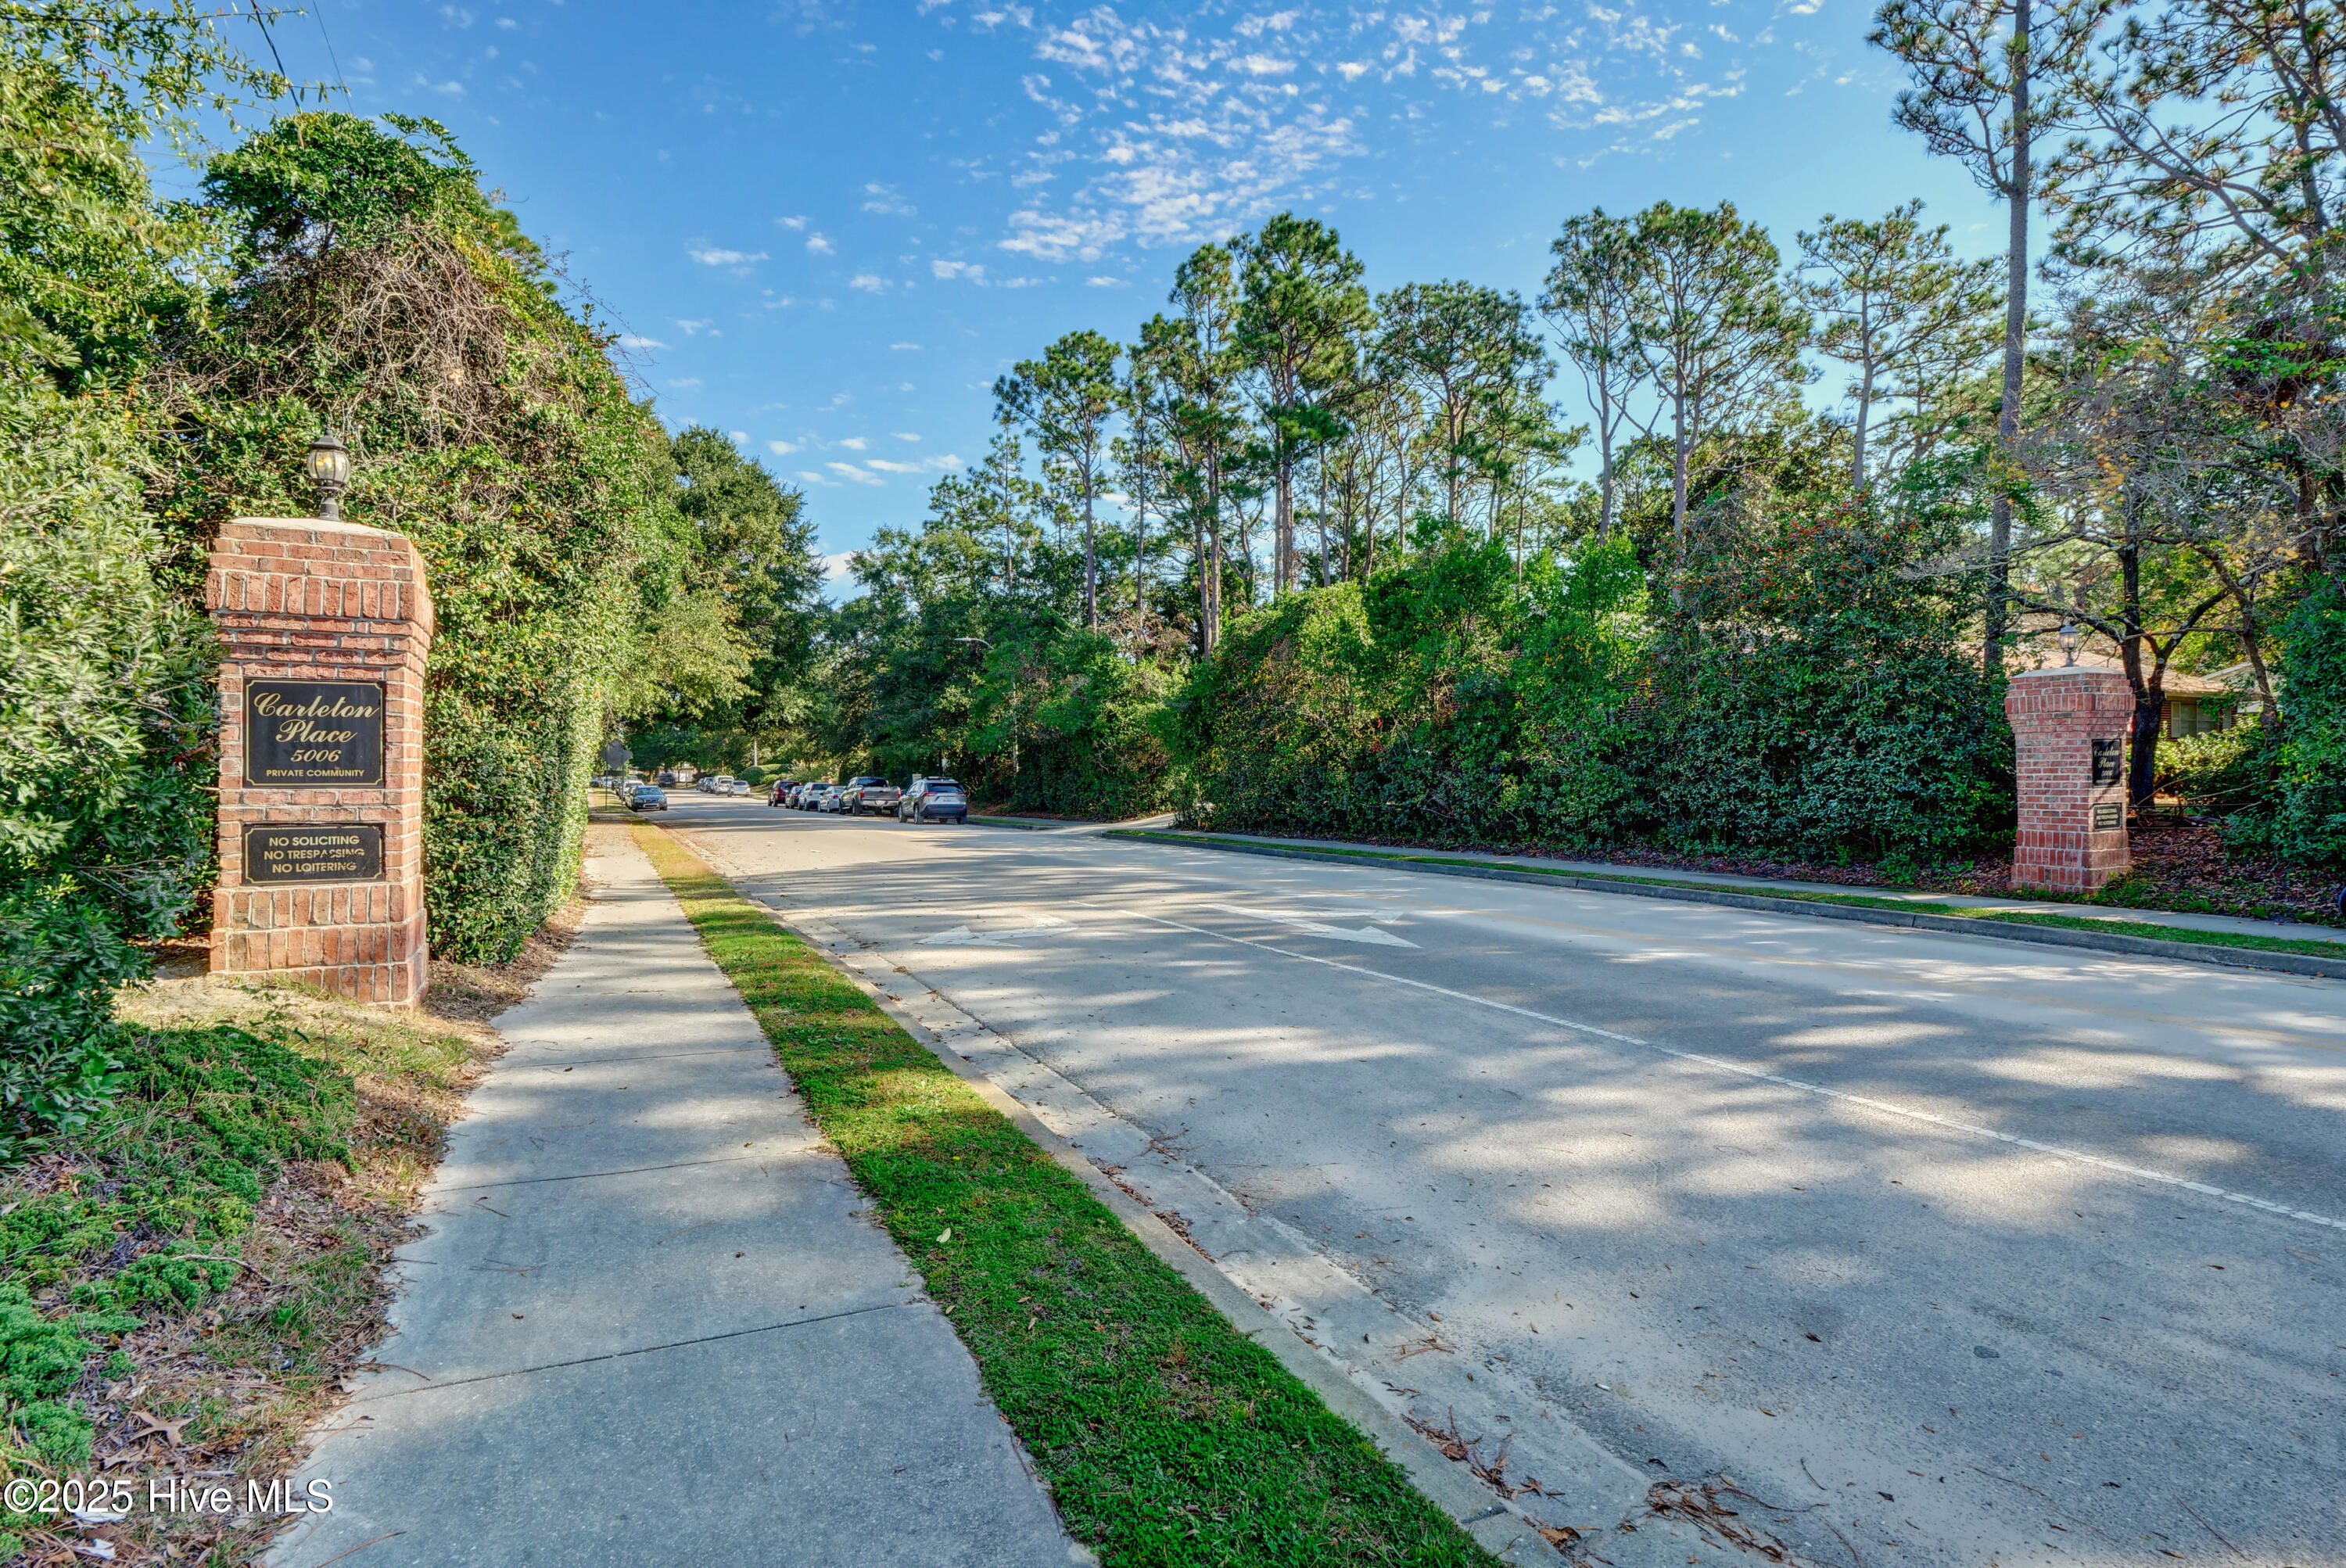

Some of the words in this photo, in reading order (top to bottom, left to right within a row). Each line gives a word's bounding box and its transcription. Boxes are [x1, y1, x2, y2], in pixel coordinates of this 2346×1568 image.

[254, 692, 380, 718] Carleton
[275, 719, 357, 743] Place
[290, 749, 342, 762] 5006
[269, 837, 289, 846] NO
[292, 835, 361, 846] SOLICITING
[264, 850, 284, 860] NO
[287, 849, 365, 859] TRESPASSING
[272, 863, 292, 873] NO
[296, 862, 357, 873] LOITERING
